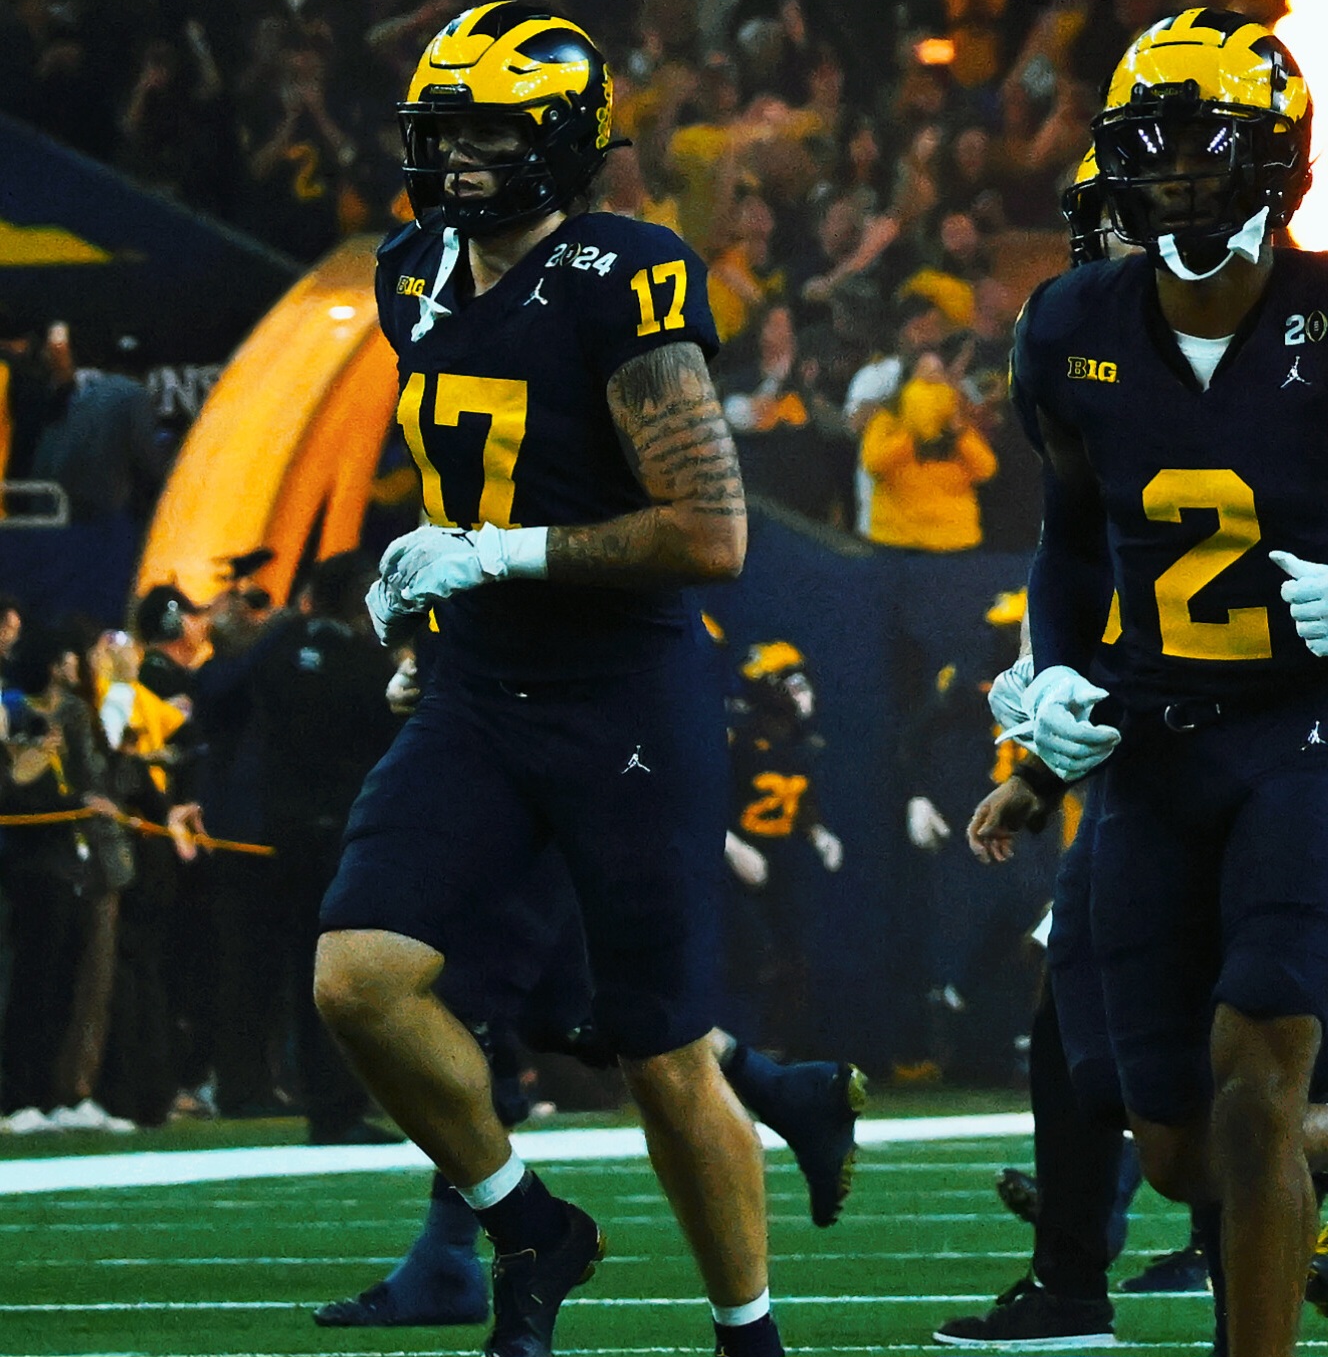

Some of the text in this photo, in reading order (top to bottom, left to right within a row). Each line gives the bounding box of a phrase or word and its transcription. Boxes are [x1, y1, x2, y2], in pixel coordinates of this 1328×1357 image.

[630, 259, 688, 338] 17
[396, 372, 527, 530] 17
[1141, 469, 1272, 660] 2
